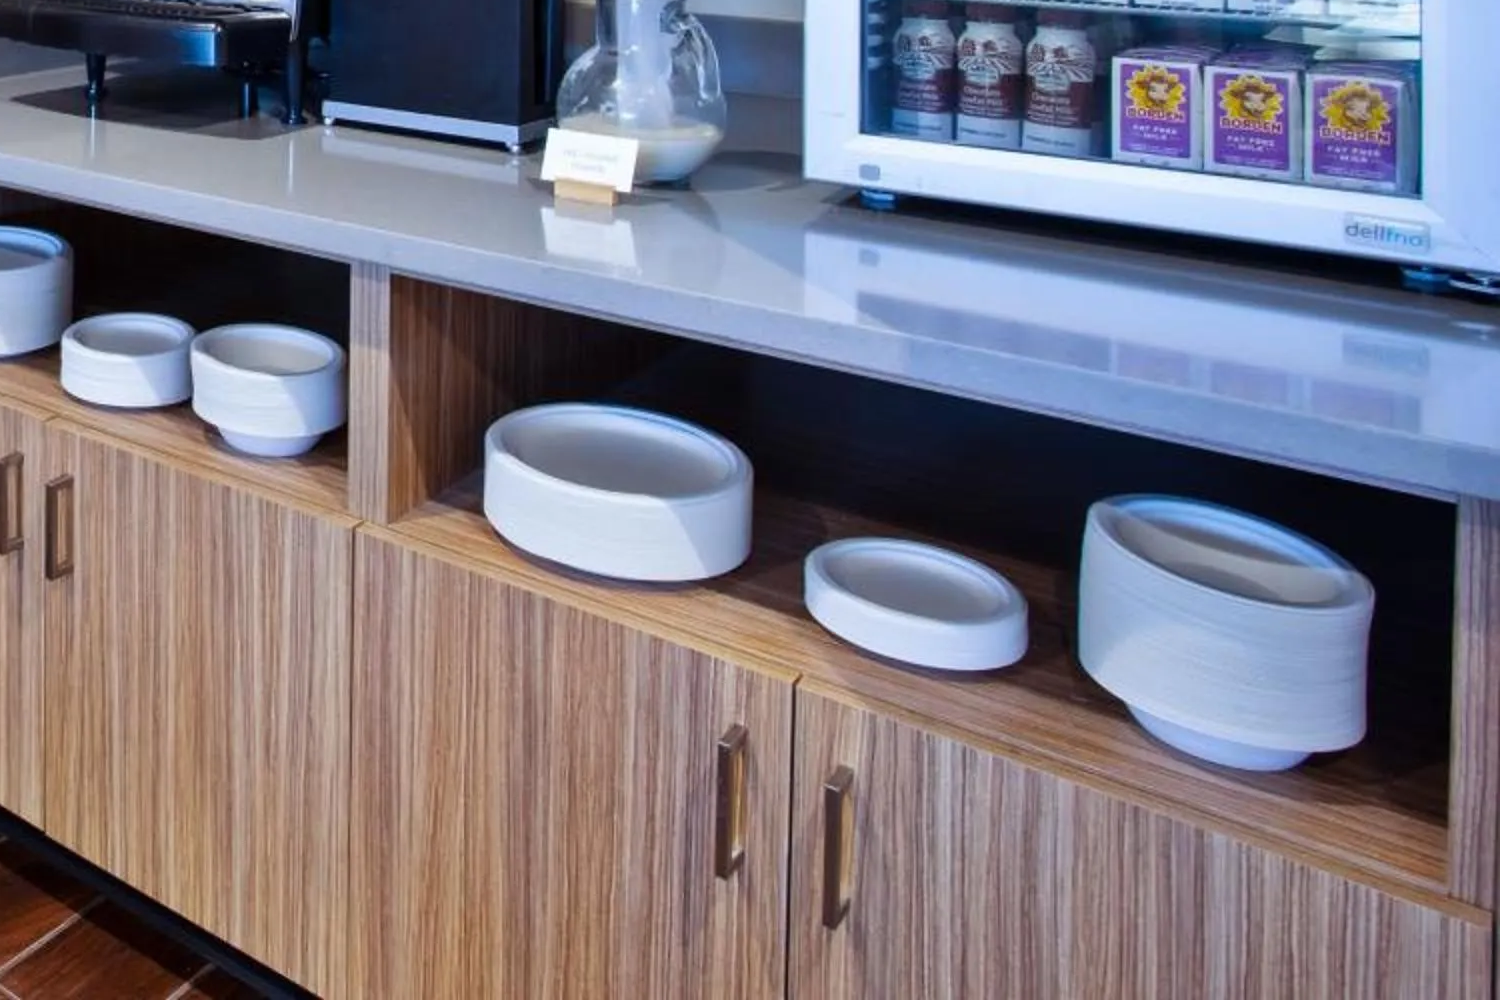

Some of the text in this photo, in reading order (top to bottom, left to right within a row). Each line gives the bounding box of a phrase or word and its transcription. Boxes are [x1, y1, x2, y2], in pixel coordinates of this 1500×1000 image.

[1126, 105, 1186, 122] BORDEN
[1220, 116, 1282, 135] BORDEN
[1320, 125, 1391, 145] BORDEN
